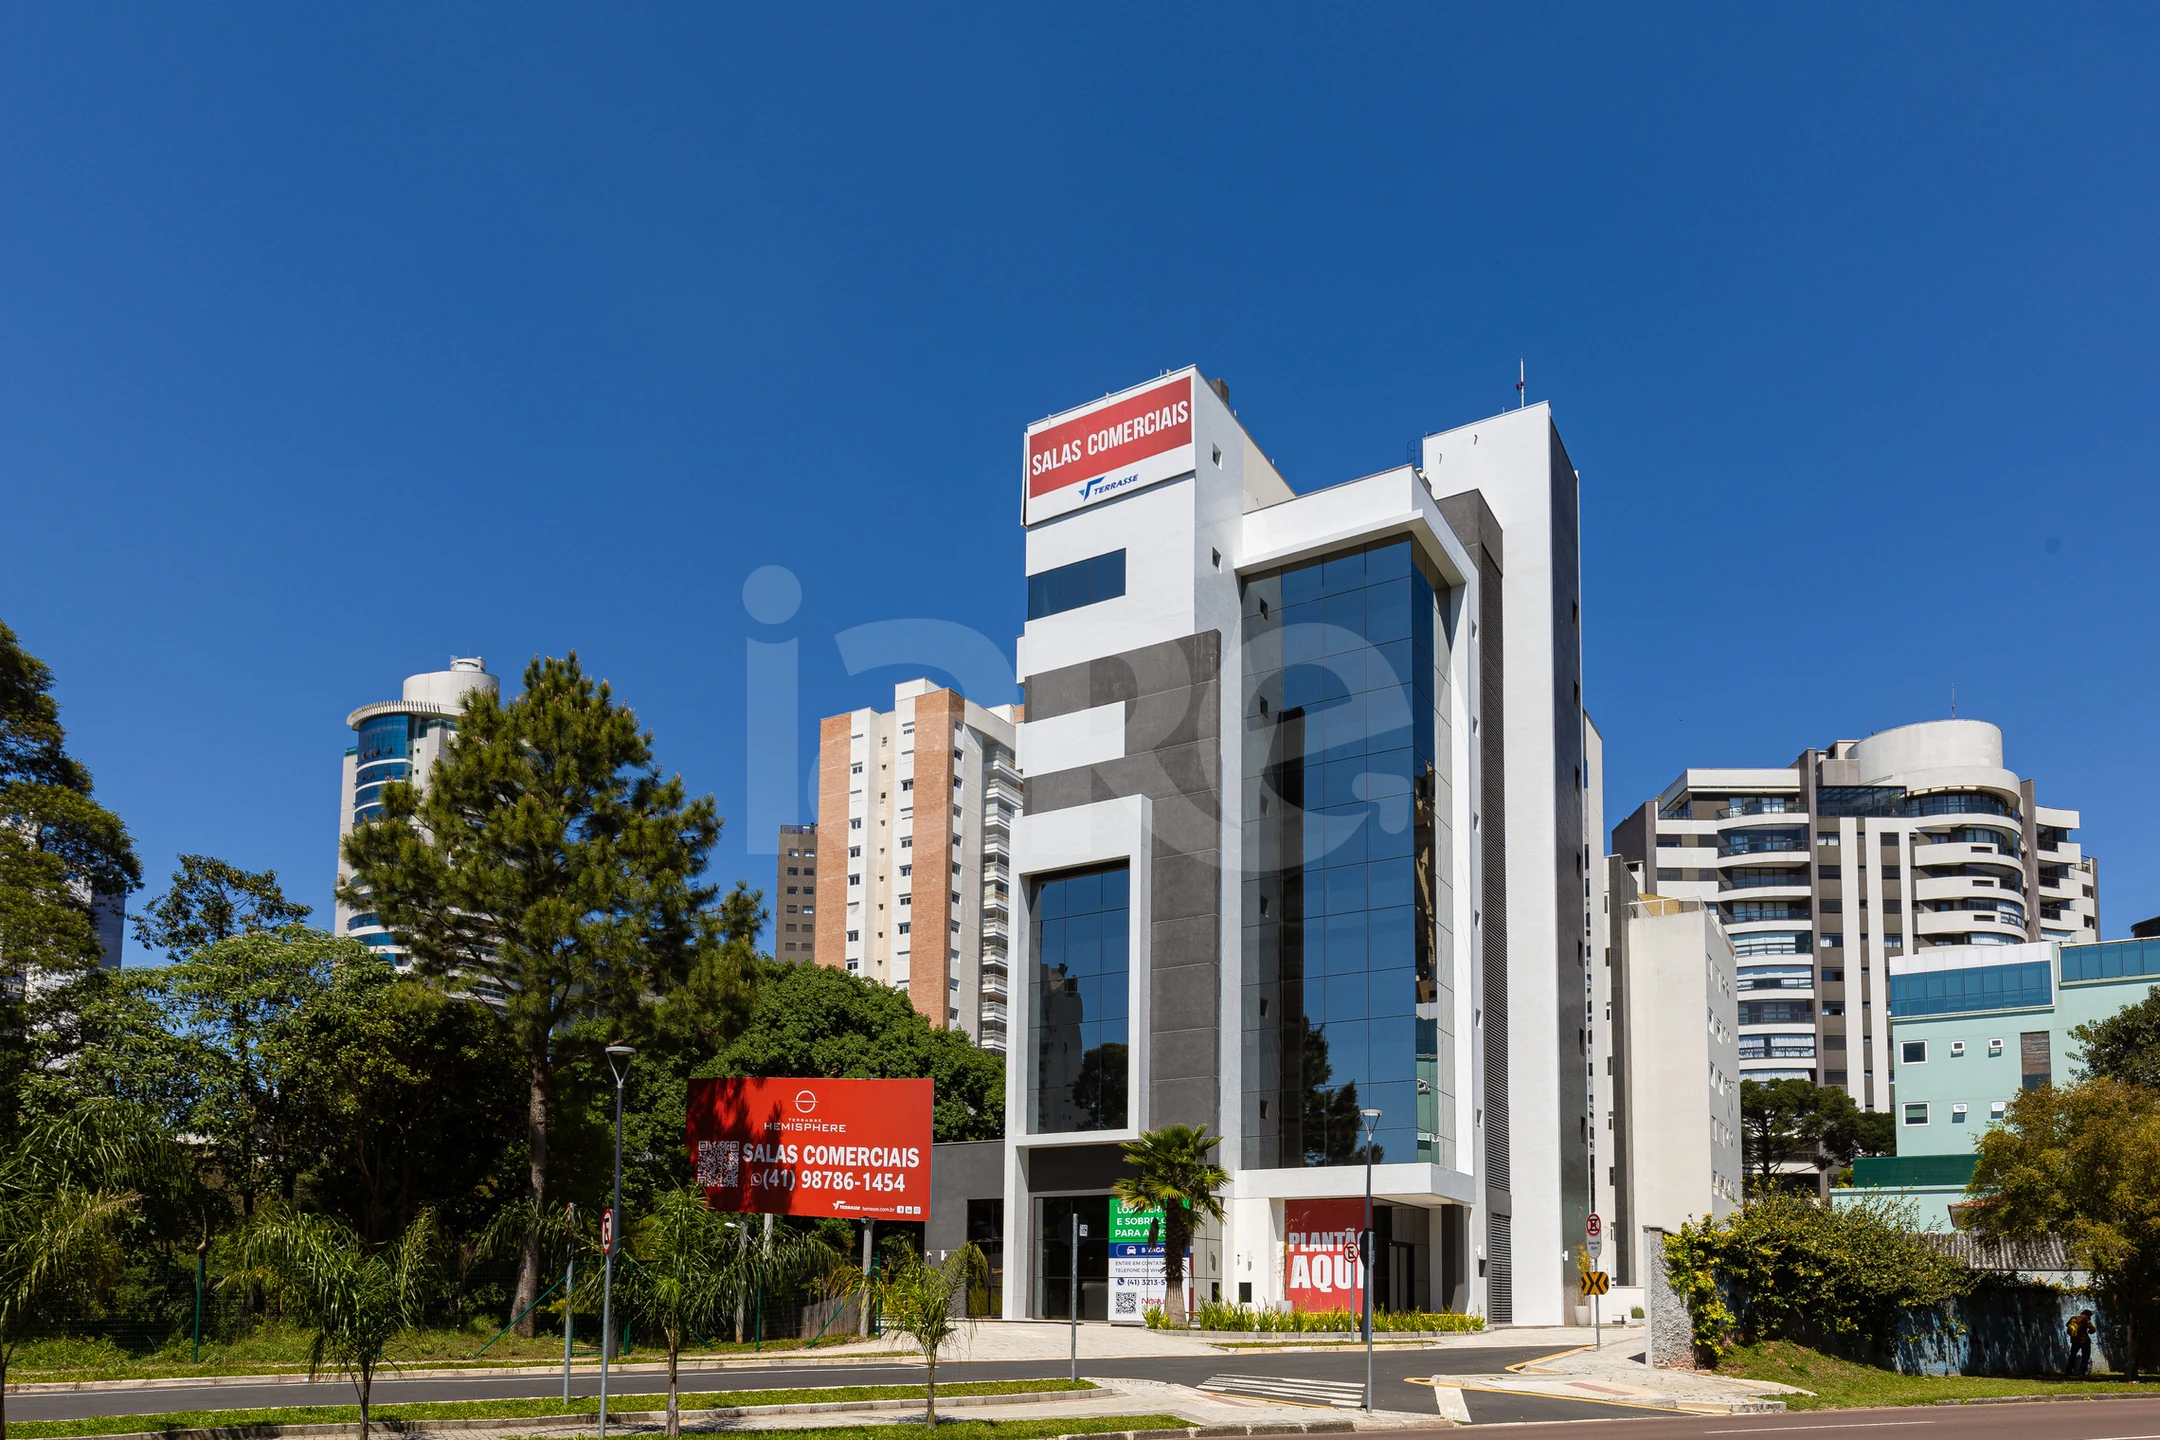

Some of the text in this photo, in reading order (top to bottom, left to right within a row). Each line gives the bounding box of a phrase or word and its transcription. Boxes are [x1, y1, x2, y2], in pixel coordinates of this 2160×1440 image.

[1032, 400, 1189, 476] SALAS COMERCIAIS
[1094, 474, 1139, 495] TERRASSE
[764, 1122, 847, 1133] HEMISPHERE
[742, 1143, 920, 1168] SALAS COMERCIAIS
[763, 1169, 905, 1192] (41) 98786-1454
[1116, 1217, 1123, 1226] E
[1115, 1229, 1141, 1237] PARA
[1127, 1279, 1140, 1287] (41)
